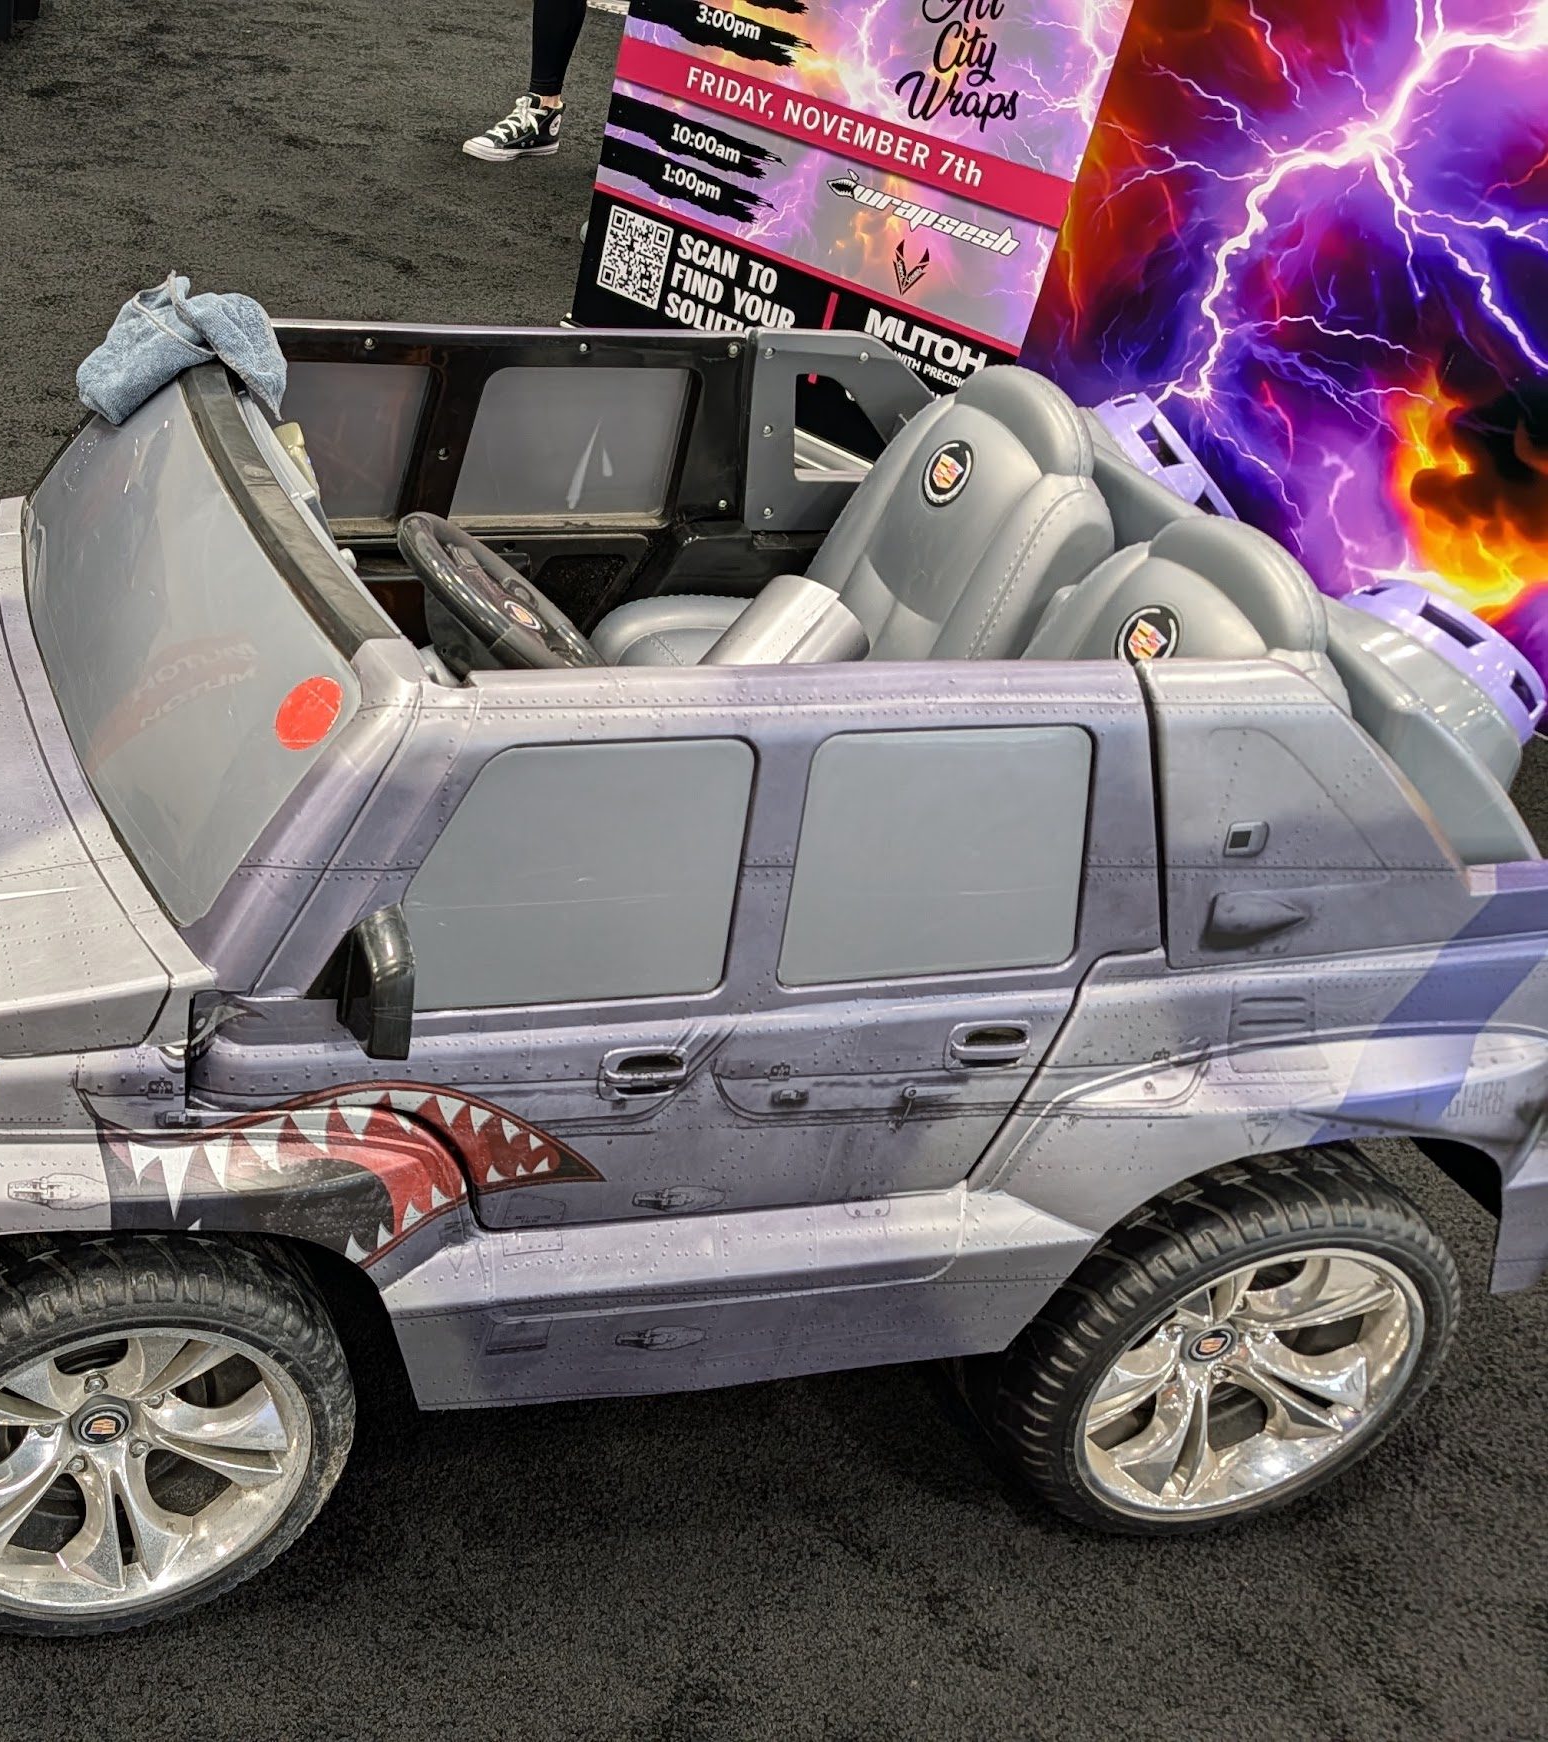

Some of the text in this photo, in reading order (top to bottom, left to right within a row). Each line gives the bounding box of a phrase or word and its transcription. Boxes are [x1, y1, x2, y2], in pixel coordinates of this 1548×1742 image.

[696, 4, 761, 40] 3:00pm
[933, 20, 997, 87] City
[686, 66, 983, 188] FRIDAY, NOVEMBER 7th
[895, 71, 1019, 133] Wraps
[671, 123, 741, 164] 10:00am
[662, 163, 721, 200] 1:00pm
[853, 184, 1021, 256] wrapsesh
[677, 233, 778, 294] SCAN TO
[671, 262, 795, 329] FIND YOUR
[864, 308, 987, 373] MUTOH
